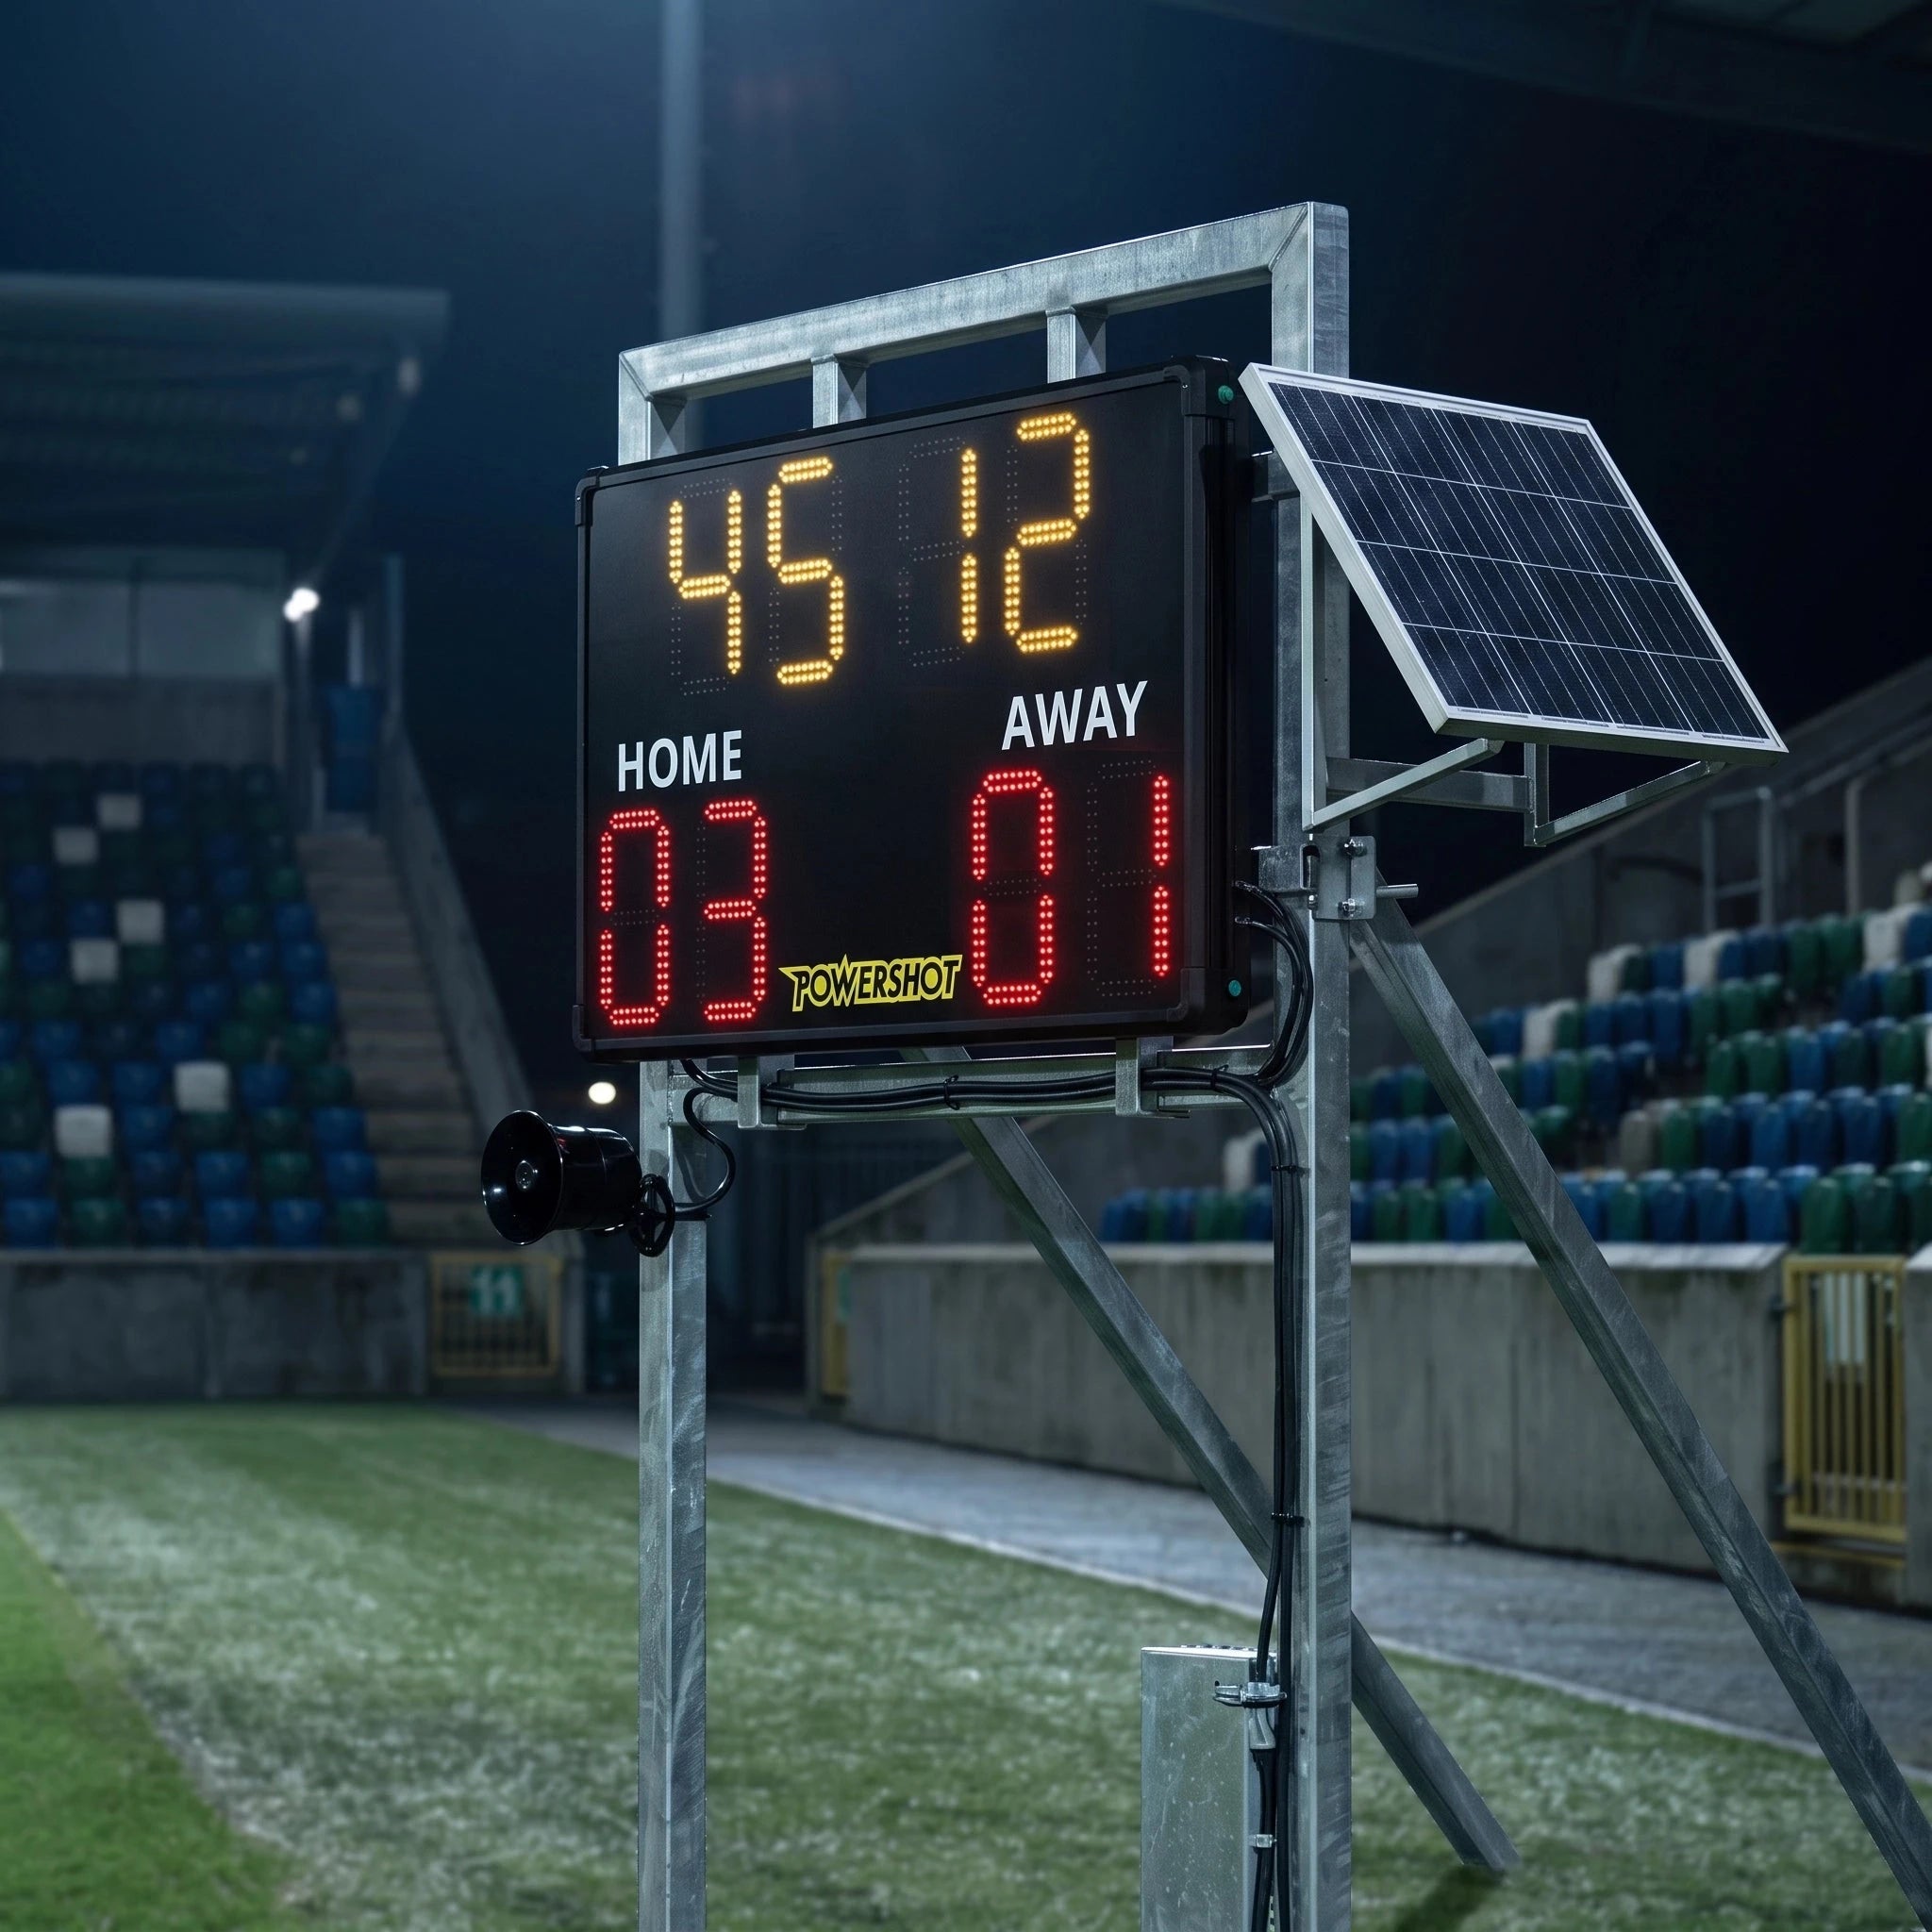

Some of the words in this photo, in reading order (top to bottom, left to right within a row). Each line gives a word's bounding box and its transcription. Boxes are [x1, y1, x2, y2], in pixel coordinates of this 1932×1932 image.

[667, 455, 846, 687] 45
[959, 411, 1092, 655] 12
[617, 729, 743, 792] HOME
[1001, 680, 1148, 751] AWAY
[599, 799, 767, 1026] 03
[972, 769, 1171, 1006] 01
[778, 953, 963, 1012] POWERSHOT
